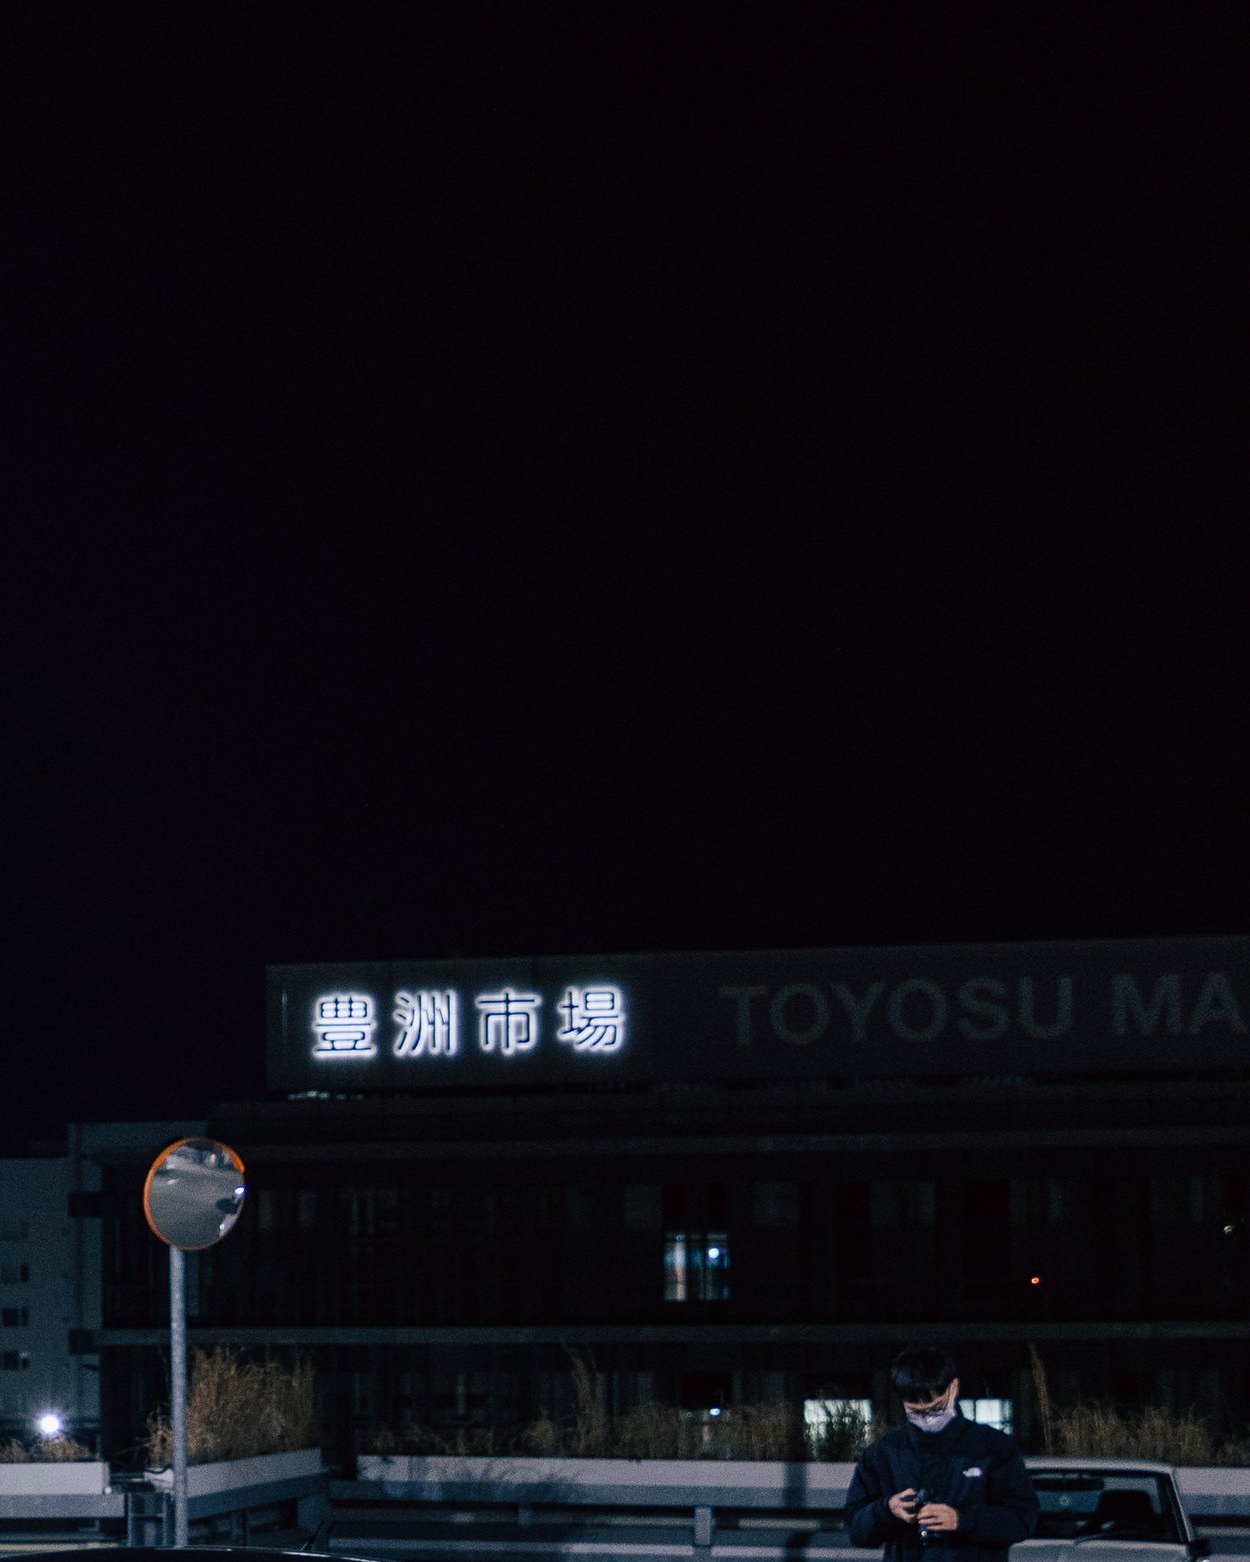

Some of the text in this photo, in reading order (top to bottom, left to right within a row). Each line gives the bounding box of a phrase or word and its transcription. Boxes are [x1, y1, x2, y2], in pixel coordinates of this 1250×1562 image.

[313, 989, 623, 1056] 豊洲市場
[718, 976, 1075, 1045] TOYOSU
